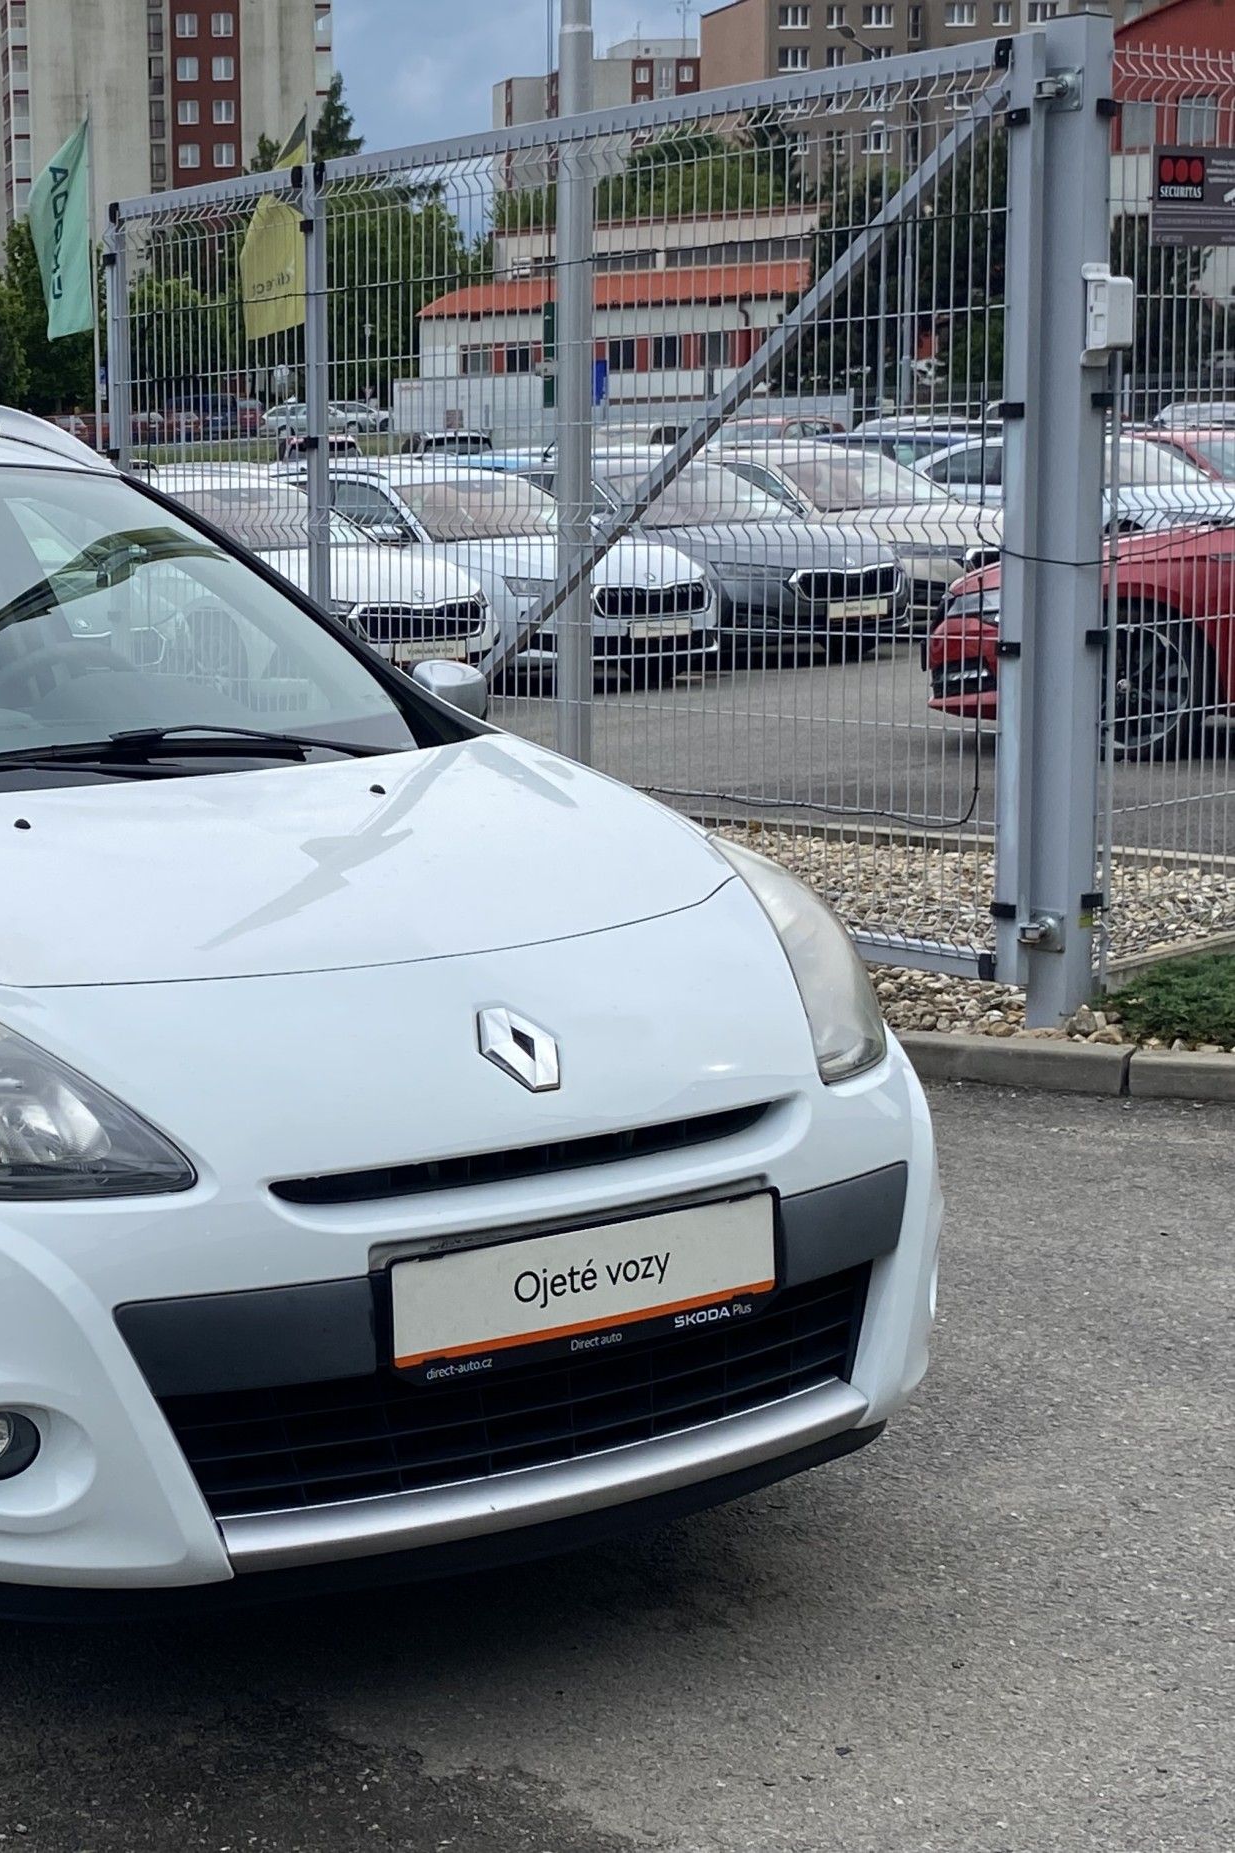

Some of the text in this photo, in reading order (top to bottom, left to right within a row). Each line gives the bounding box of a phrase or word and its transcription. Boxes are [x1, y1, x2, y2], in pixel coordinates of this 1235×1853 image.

[1159, 185, 1202, 199] SECURITAS
[514, 1252, 670, 1308] Ojeté vozy
[732, 1303, 752, 1316] Plus
[570, 1333, 623, 1351] Direct auto
[426, 1357, 493, 1380] direct-auto.cz
